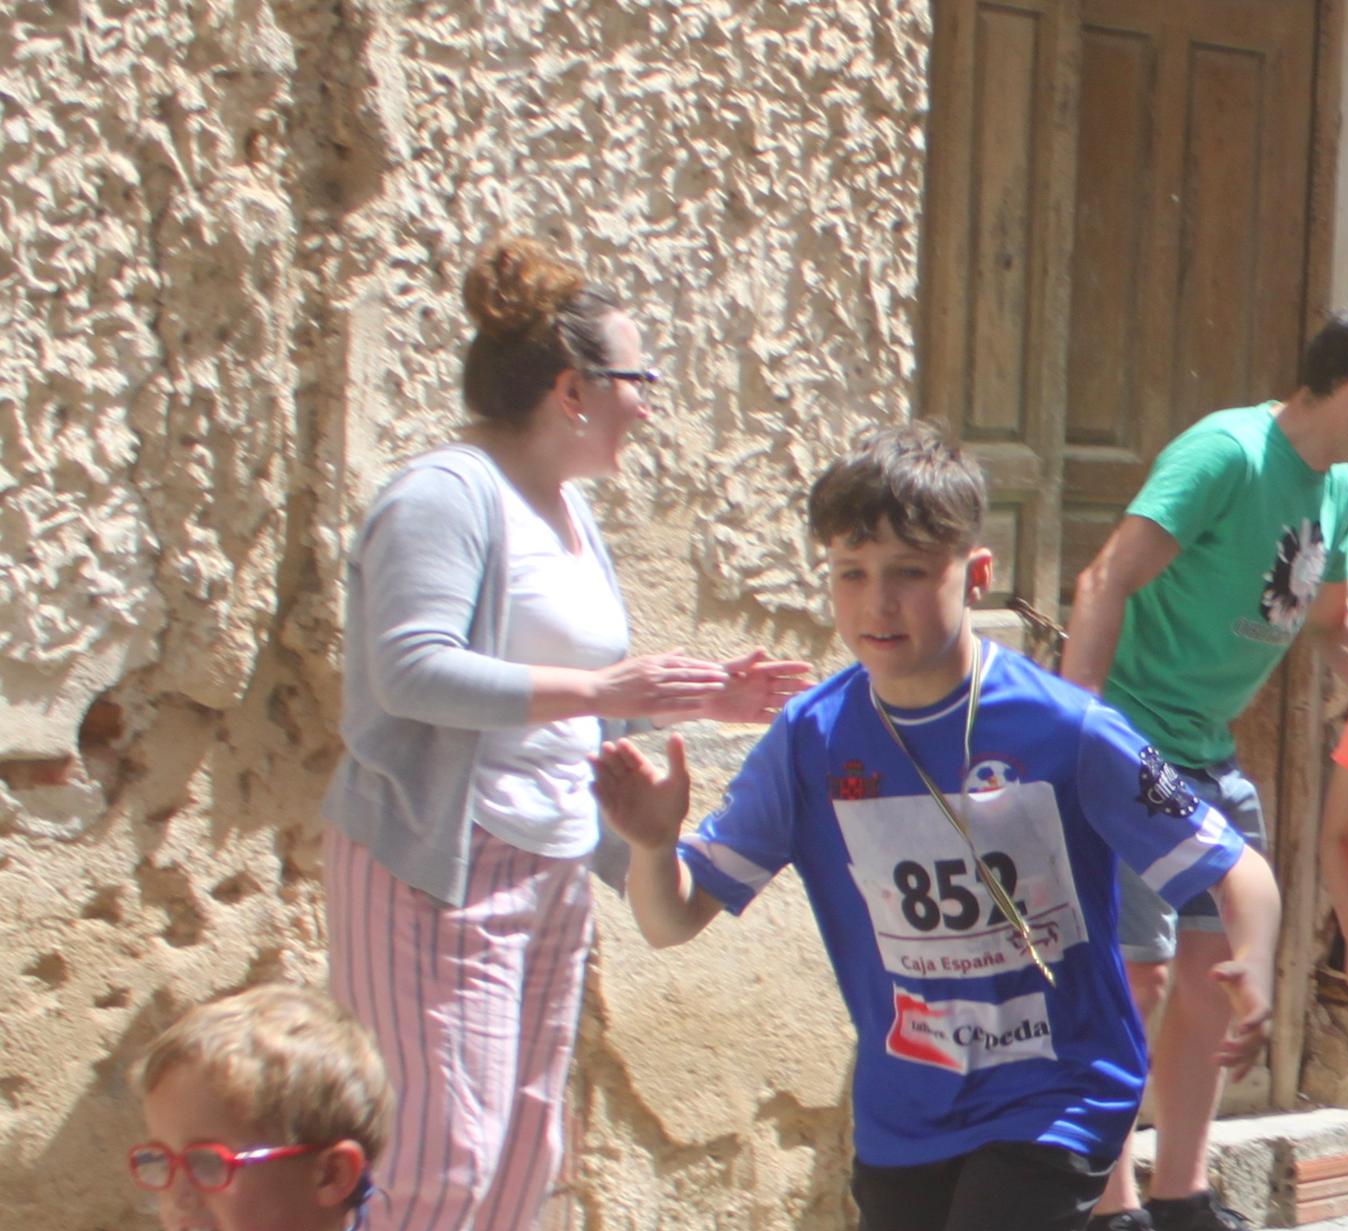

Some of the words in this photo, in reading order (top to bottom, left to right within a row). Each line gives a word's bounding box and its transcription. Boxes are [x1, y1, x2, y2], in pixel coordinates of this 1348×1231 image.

[893, 851, 1027, 932] 852
[901, 955, 936, 976] Caja
[940, 951, 1005, 974] España
[953, 1018, 1050, 1050] Cepeda
